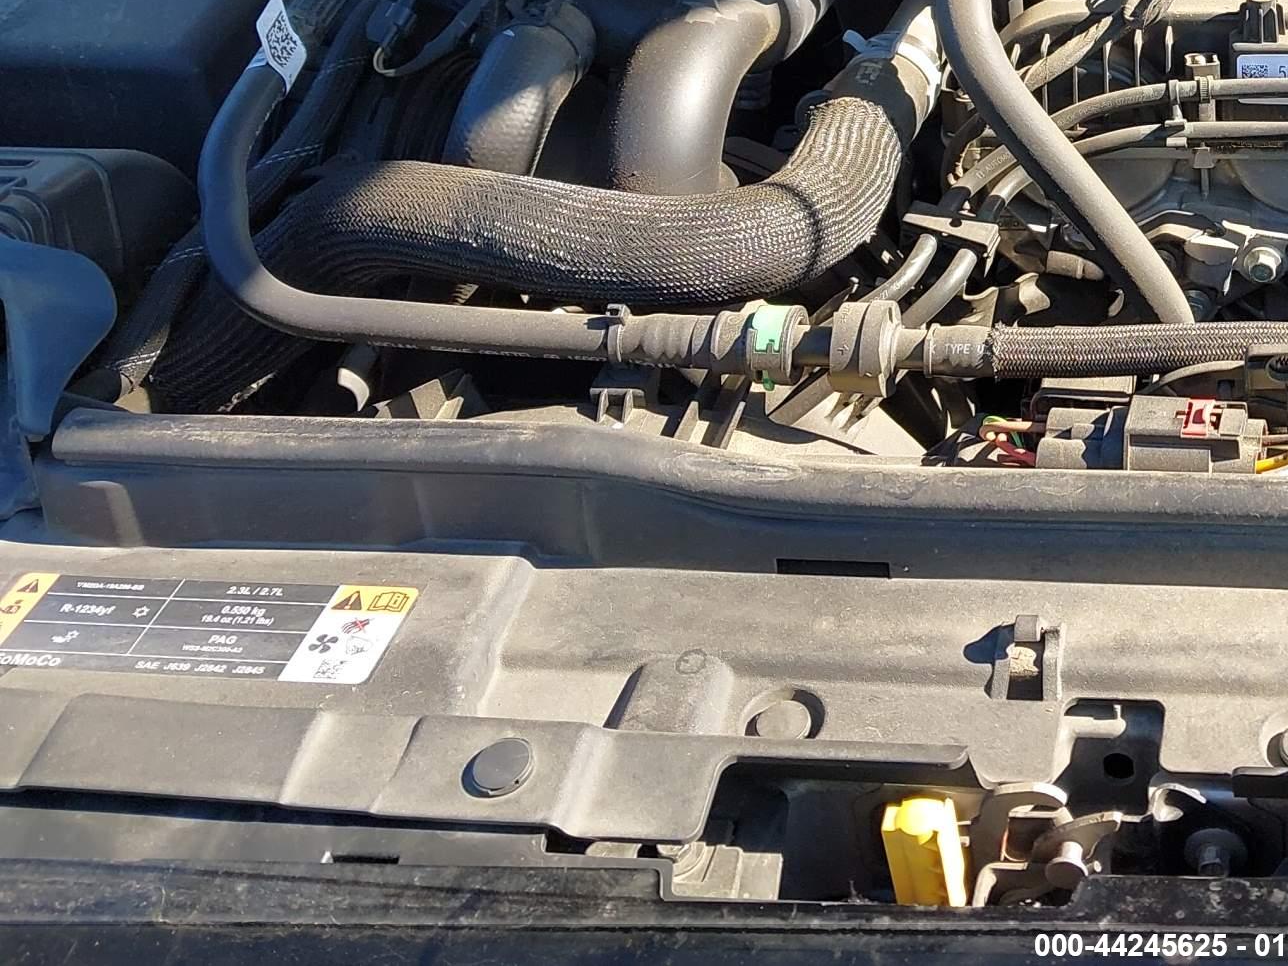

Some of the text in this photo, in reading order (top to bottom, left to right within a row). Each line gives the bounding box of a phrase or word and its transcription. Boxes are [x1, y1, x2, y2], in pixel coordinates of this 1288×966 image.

[944, 343, 971, 355] TYPE
[60, 603, 116, 616] R-1234yf
[251, 606, 267, 617] kg
[207, 635, 238, 644] PAG
[134, 660, 160, 669] SAE
